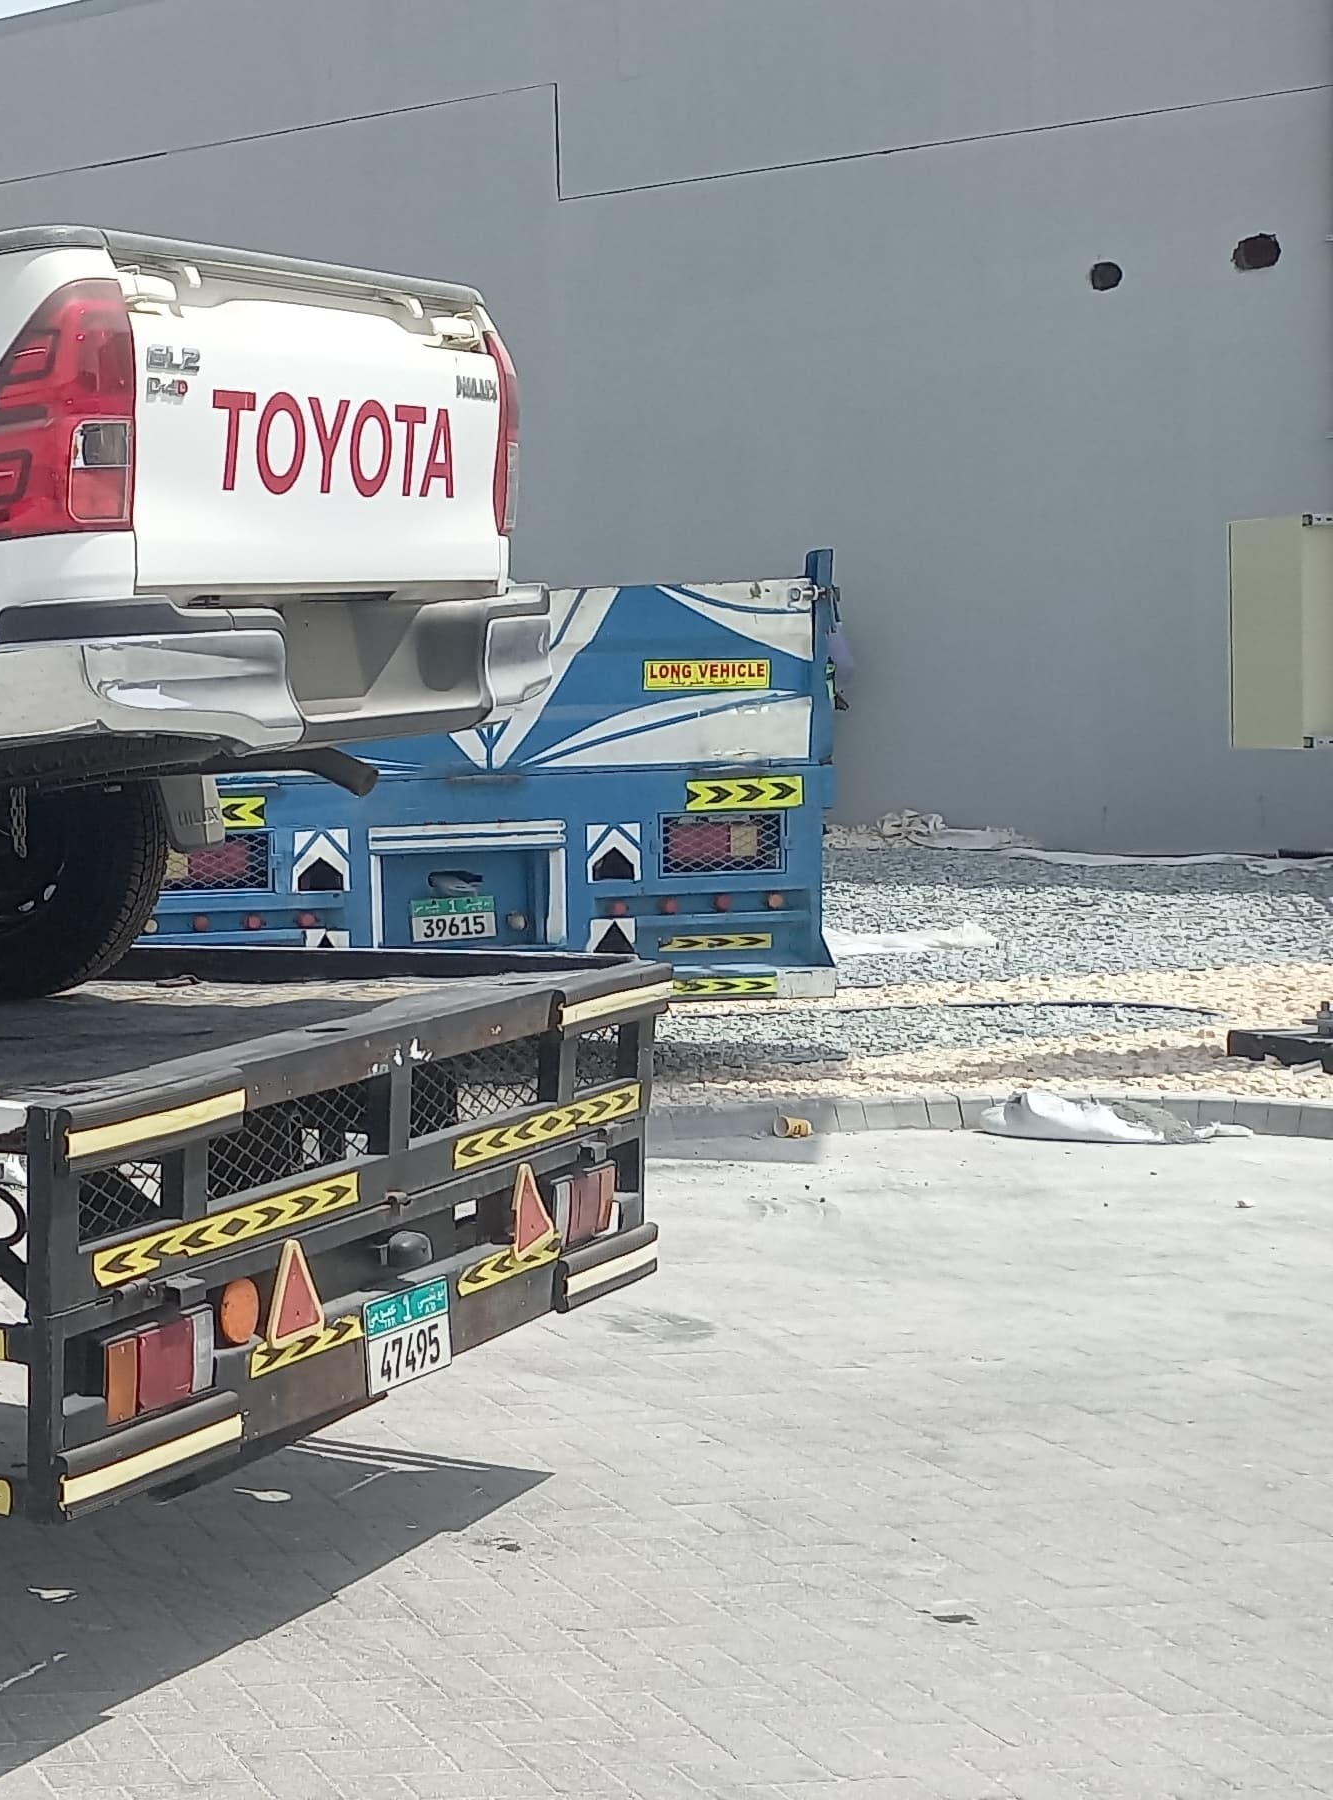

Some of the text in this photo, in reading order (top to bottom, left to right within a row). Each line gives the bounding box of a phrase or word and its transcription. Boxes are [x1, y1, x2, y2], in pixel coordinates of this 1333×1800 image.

[212, 389, 454, 499] TOYOTA
[649, 663, 766, 679] LONG VEHICLE
[448, 900, 457, 912] 1
[422, 915, 486, 938] 39615
[402, 1294, 413, 1321] 1
[380, 1323, 441, 1382] 47495
